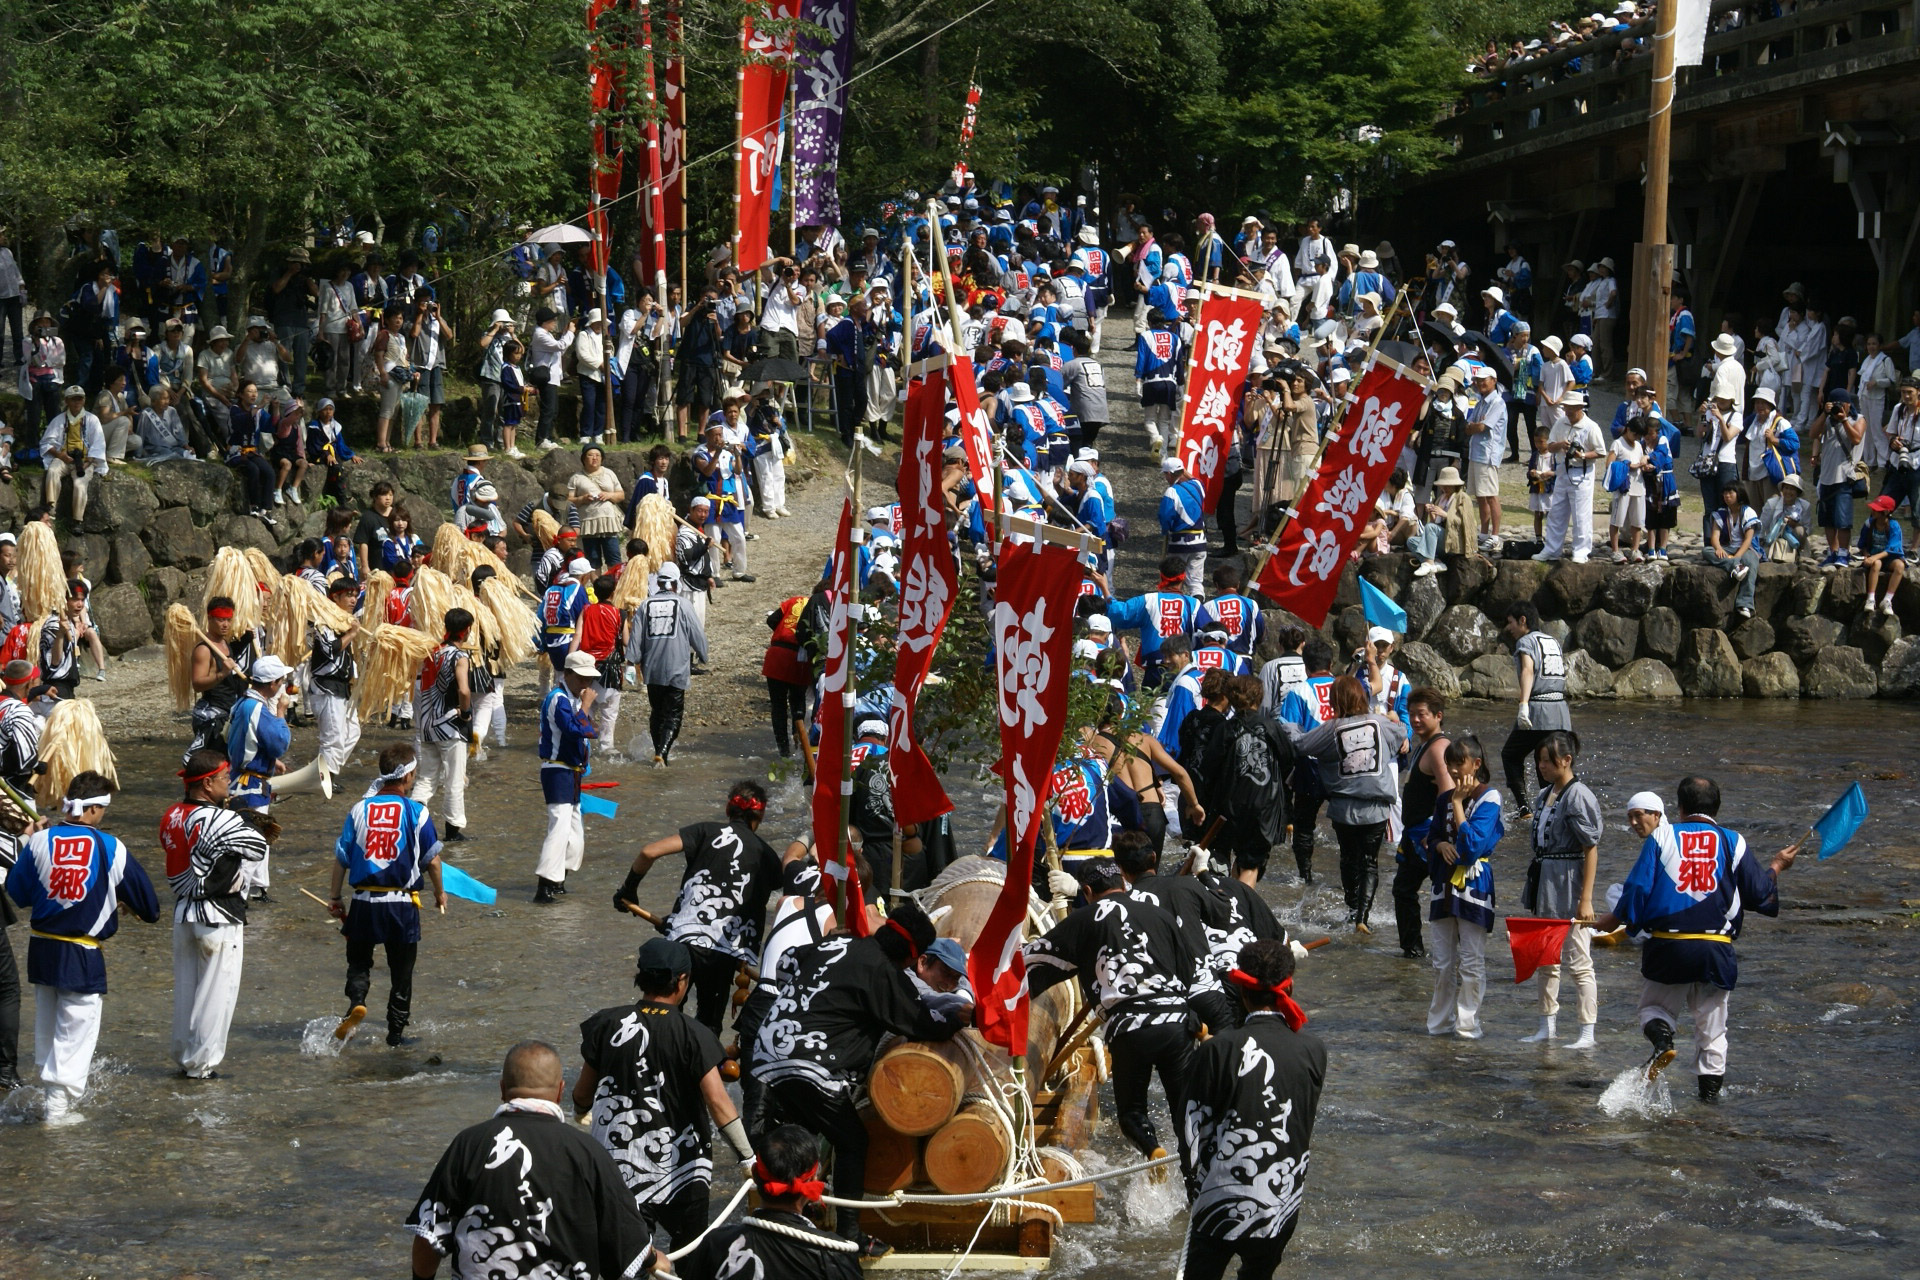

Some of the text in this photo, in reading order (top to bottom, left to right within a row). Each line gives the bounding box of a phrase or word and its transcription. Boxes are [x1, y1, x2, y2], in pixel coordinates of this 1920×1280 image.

[1155, 332, 1171, 358] 四郷
[1160, 598, 1183, 638] 四郷
[1218, 599, 1242, 636] 四郷
[365, 801, 402, 861] 四郷
[1677, 831, 1717, 893] 四郷
[48, 836, 94, 902] 四郷
[610, 1012, 666, 1112] あさま
[1238, 1036, 1293, 1144] あさま
[484, 1126, 553, 1246] あさま
